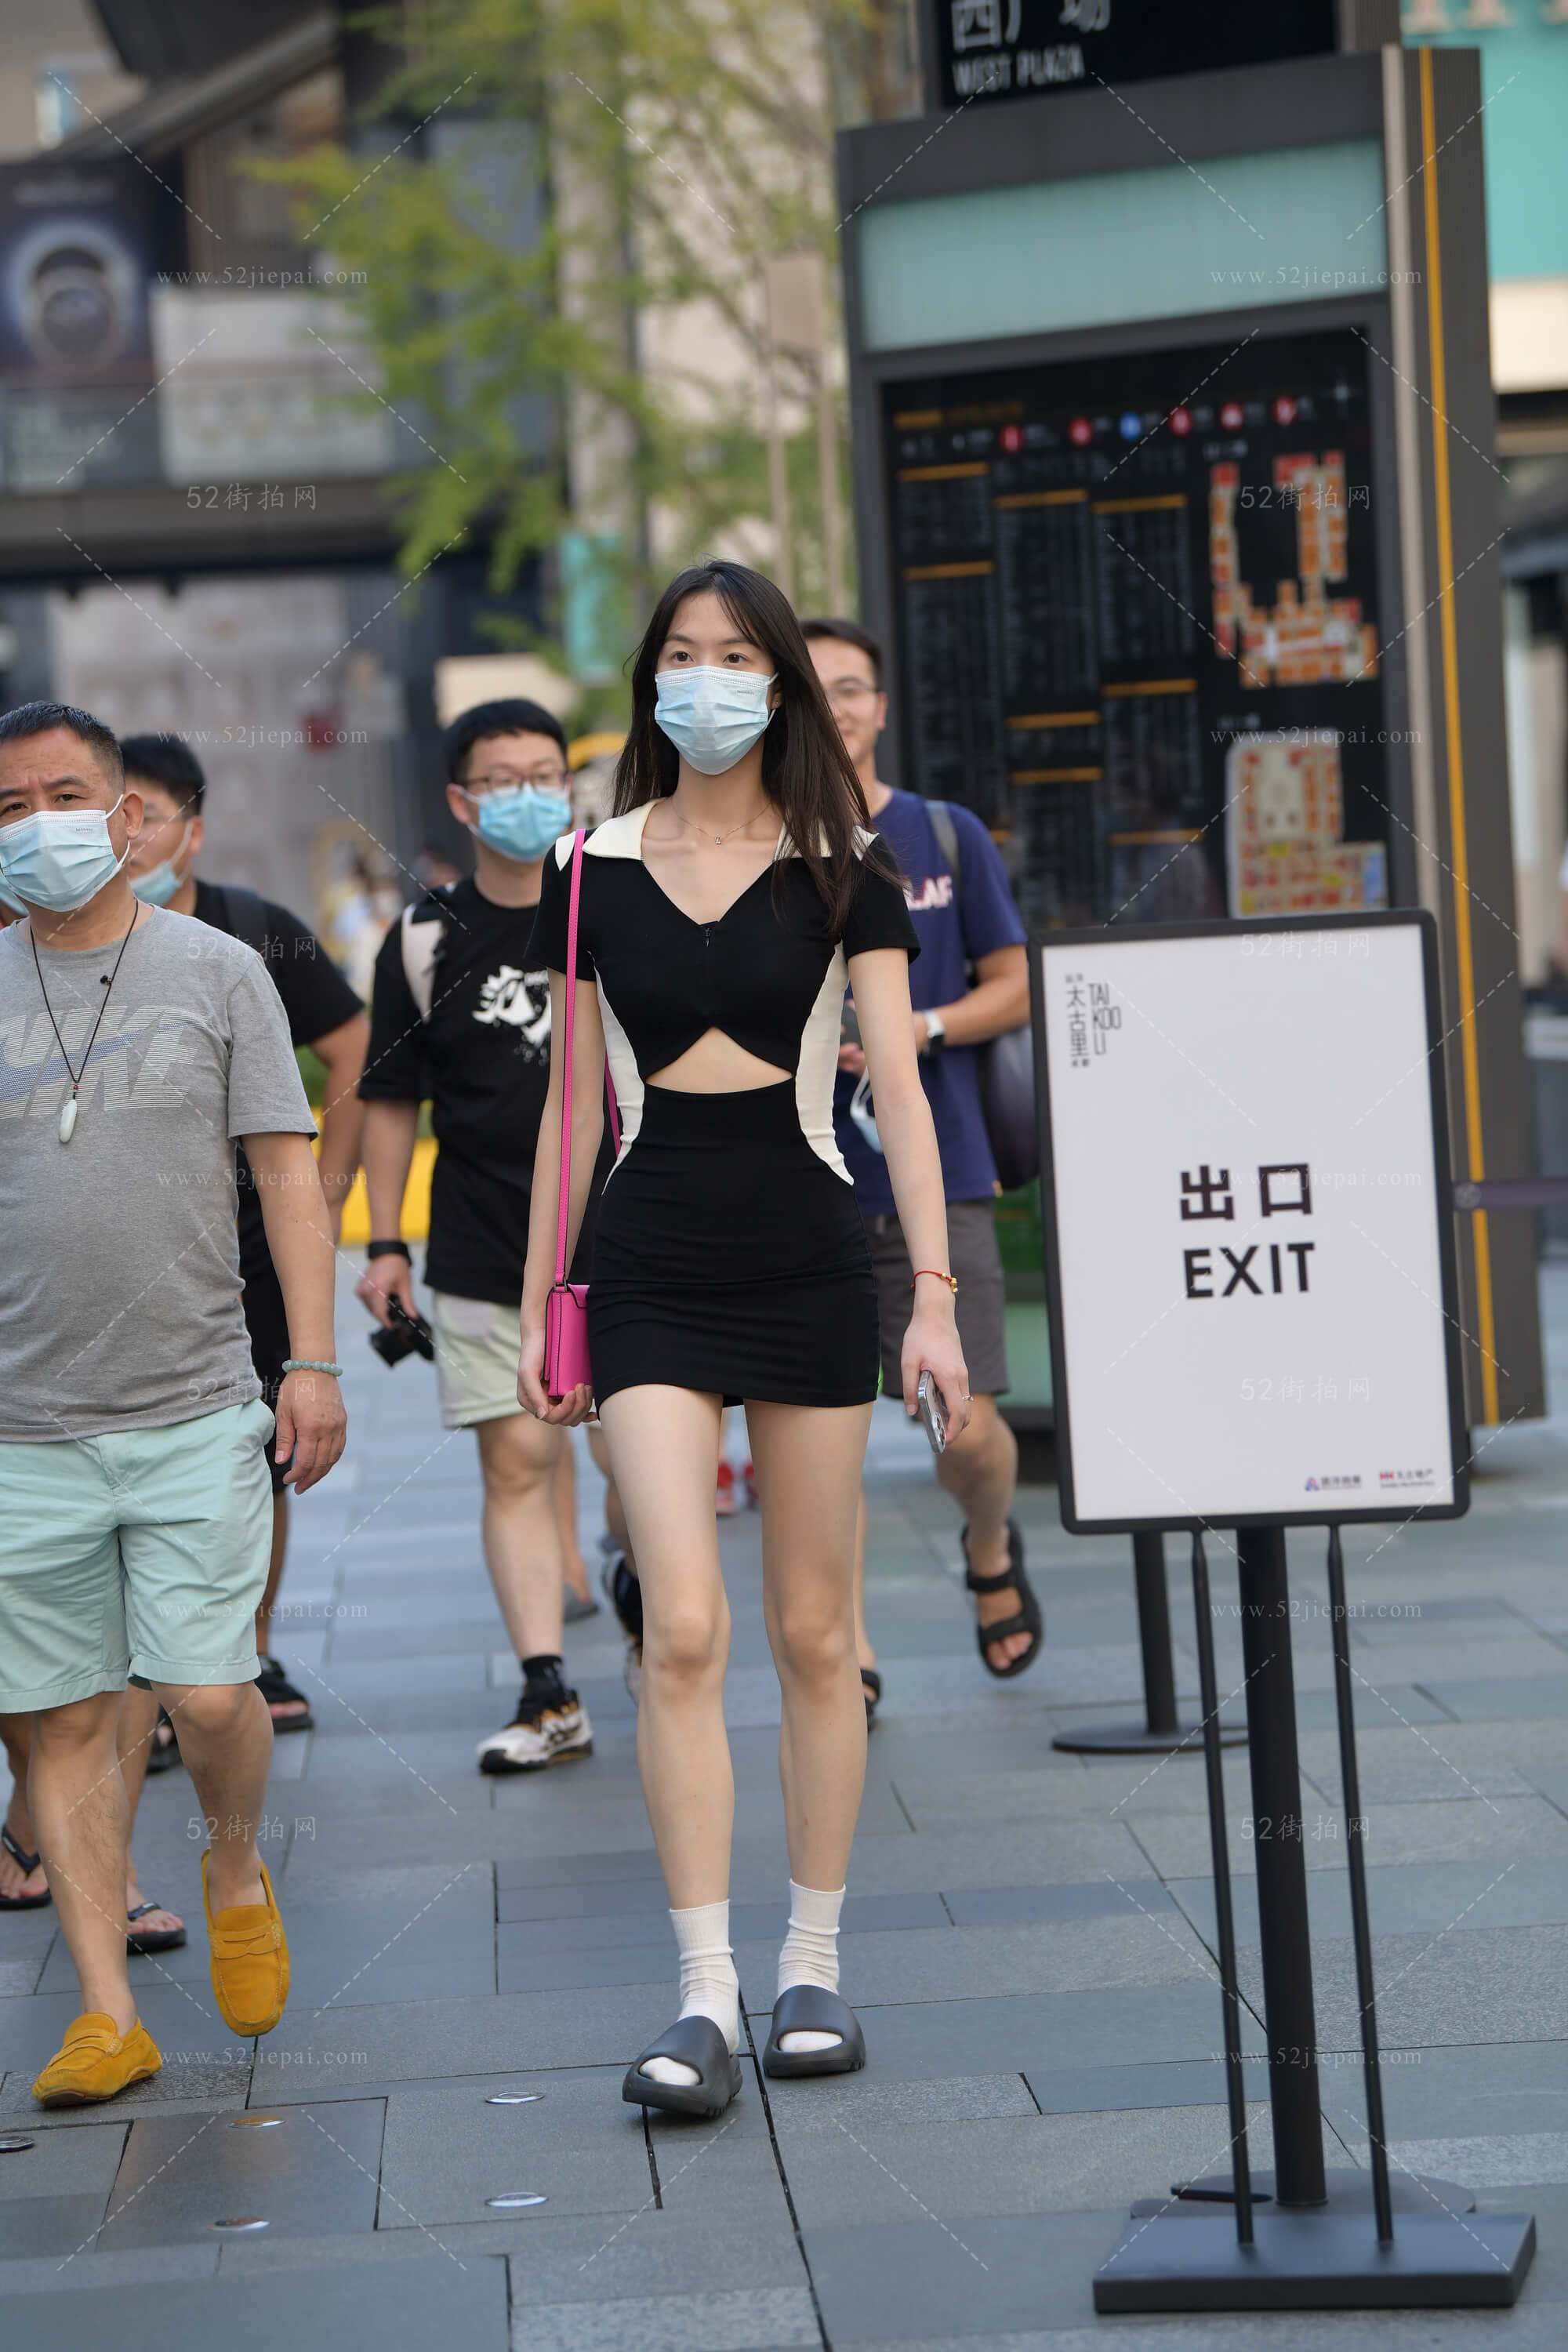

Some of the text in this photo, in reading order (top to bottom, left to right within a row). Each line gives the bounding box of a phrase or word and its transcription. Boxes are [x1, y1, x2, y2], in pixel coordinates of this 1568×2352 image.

[953, 43, 1085, 96] WEST PLAZA
[1066, 985, 1089, 1057] 太古里
[1088, 982, 1110, 1006] TAI
[1092, 1006, 1122, 1030] KOO
[1180, 1163, 1312, 1221] 出口
[1183, 1242, 1316, 1298] EXIT
